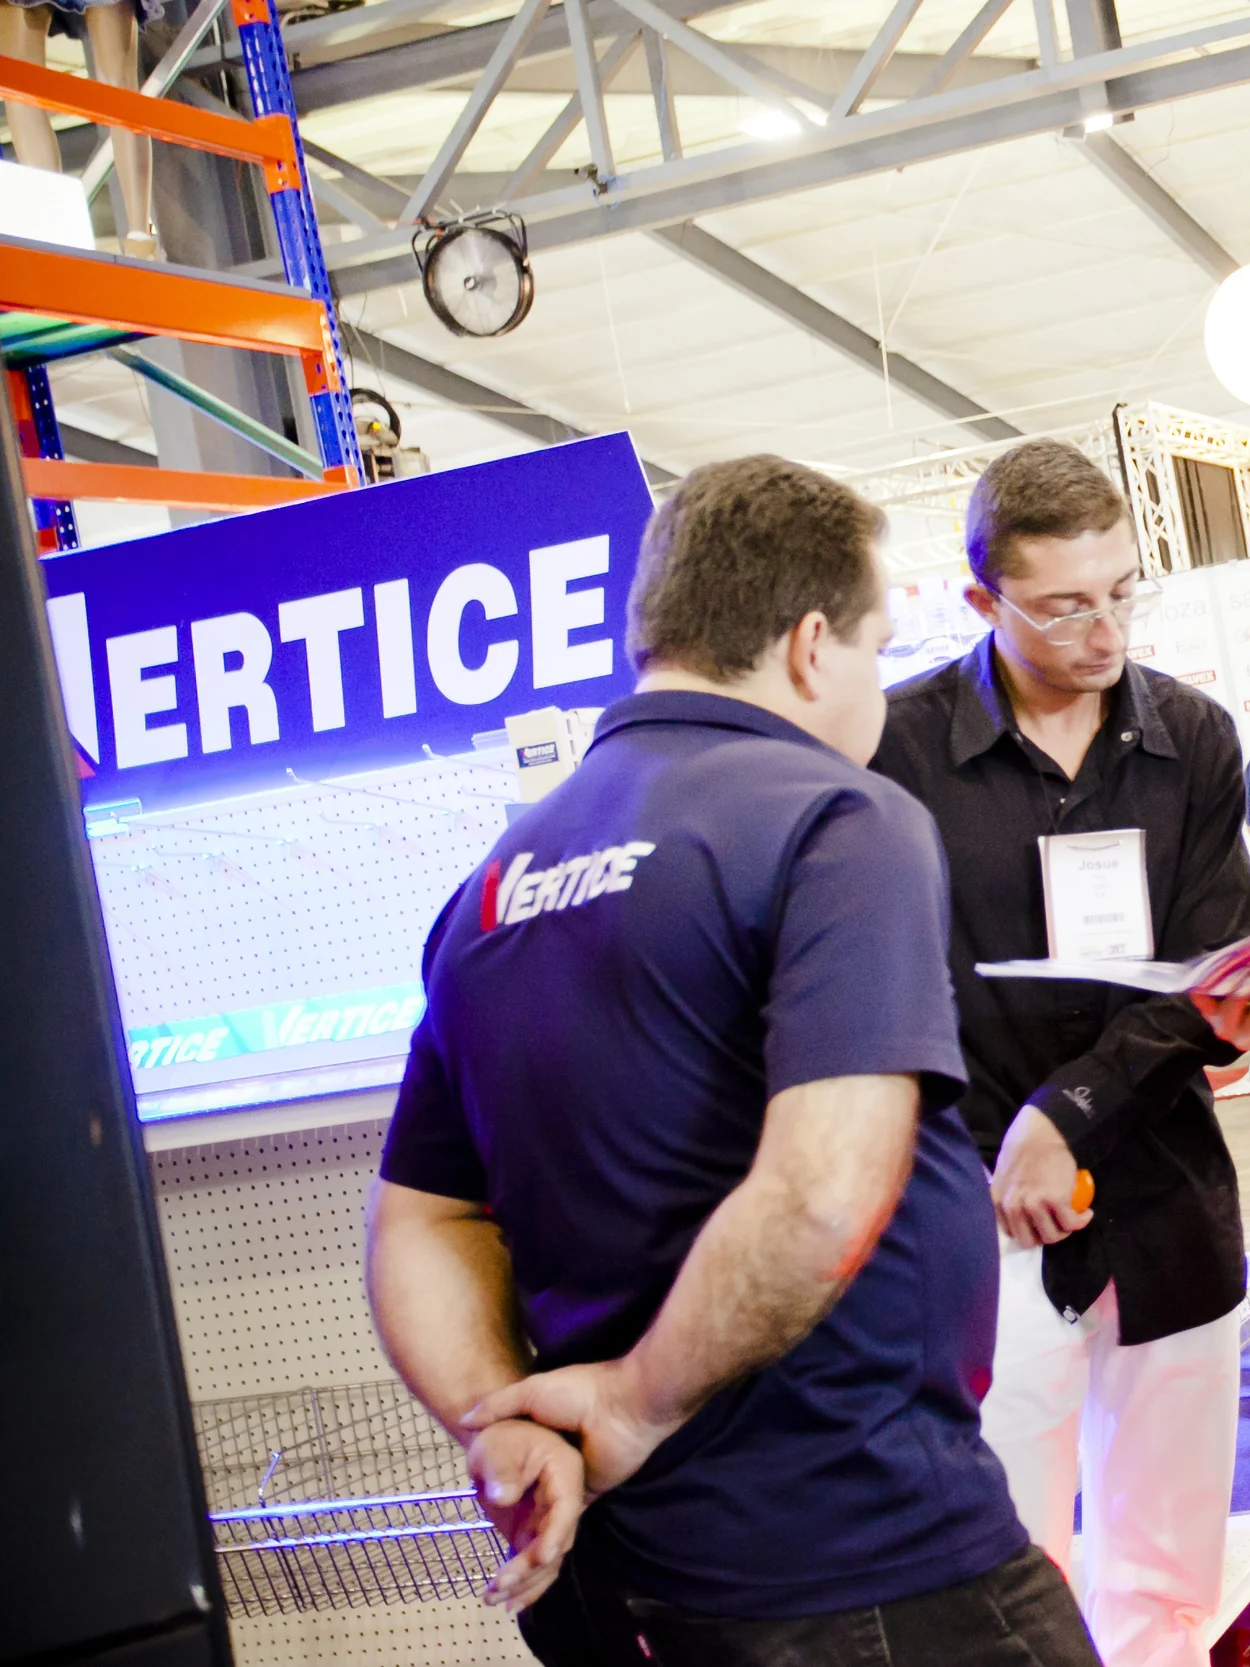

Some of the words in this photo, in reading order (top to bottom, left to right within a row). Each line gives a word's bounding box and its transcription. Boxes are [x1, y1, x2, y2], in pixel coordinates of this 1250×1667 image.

[480, 841, 657, 933] VERTICE
[1078, 859, 1120, 871] Josue
[129, 1026, 230, 1070] RTICE
[262, 996, 424, 1050] VERTICE
